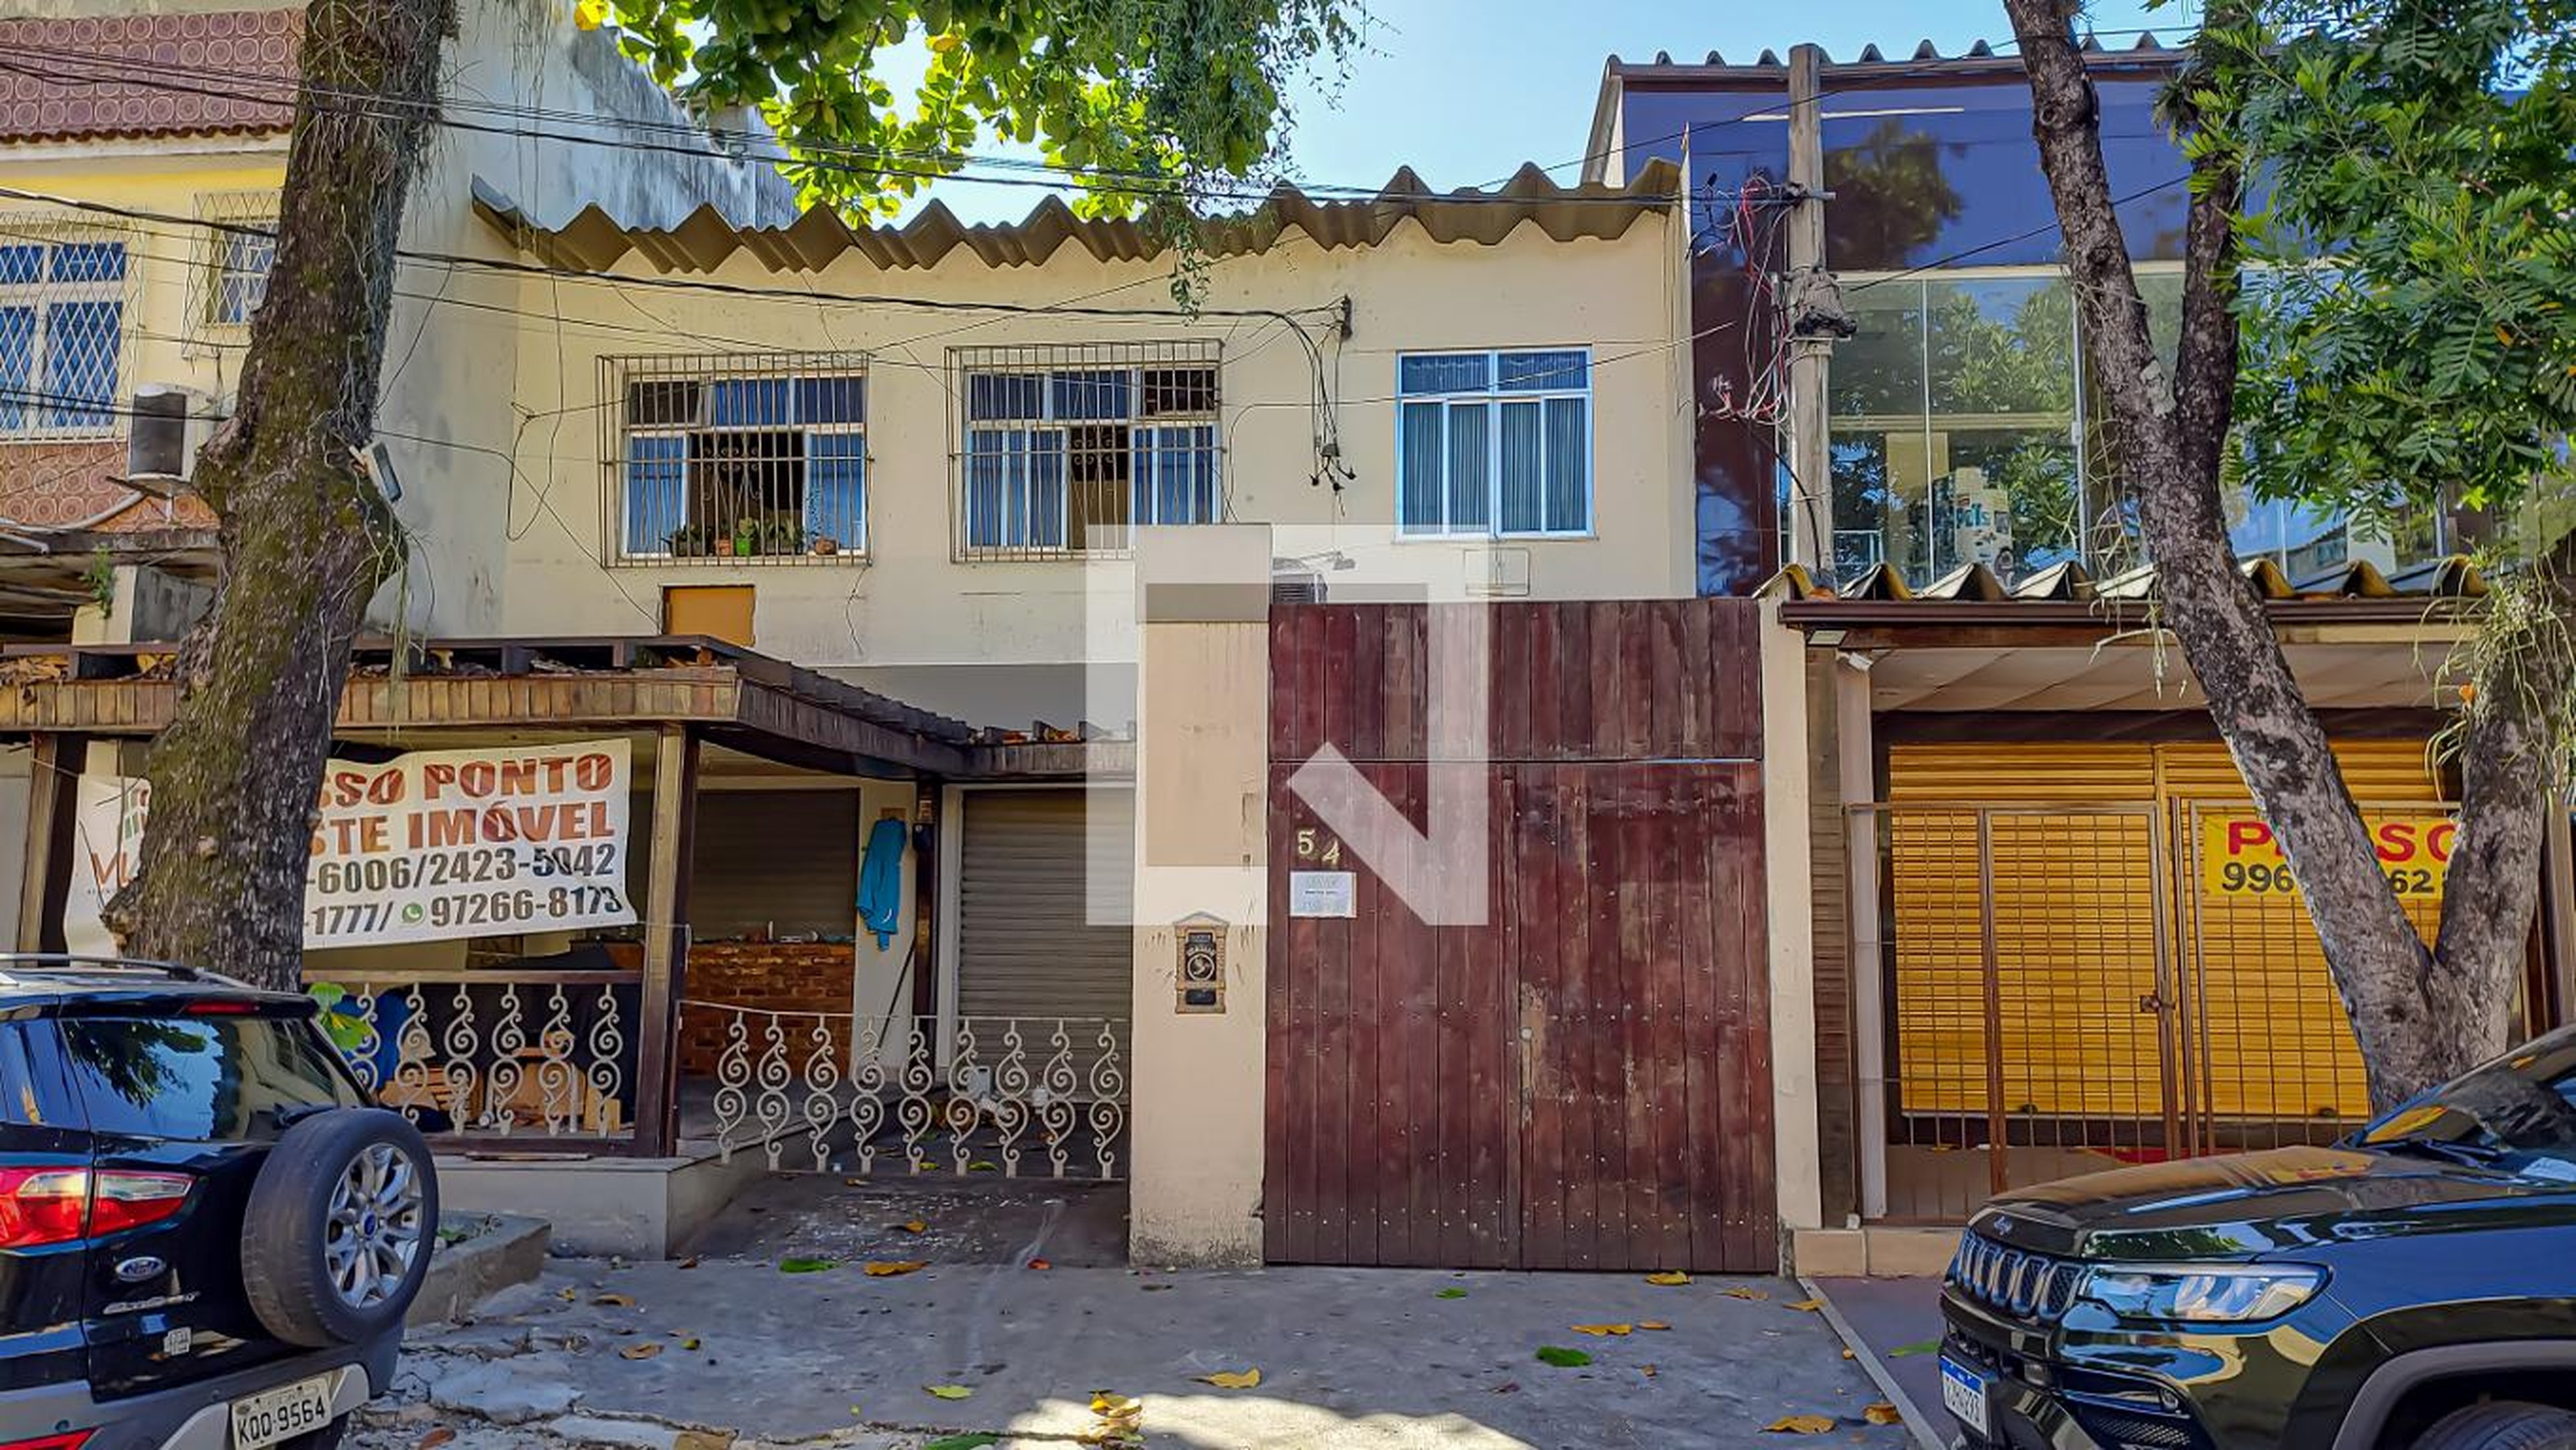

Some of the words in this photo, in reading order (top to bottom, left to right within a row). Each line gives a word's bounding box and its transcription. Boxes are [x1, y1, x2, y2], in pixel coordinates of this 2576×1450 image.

[424, 753, 612, 800] PONTO
[408, 801, 615, 849] IMÓVEL
[1298, 829, 1340, 866] 54
[431, 886, 623, 928] 97266-8173
